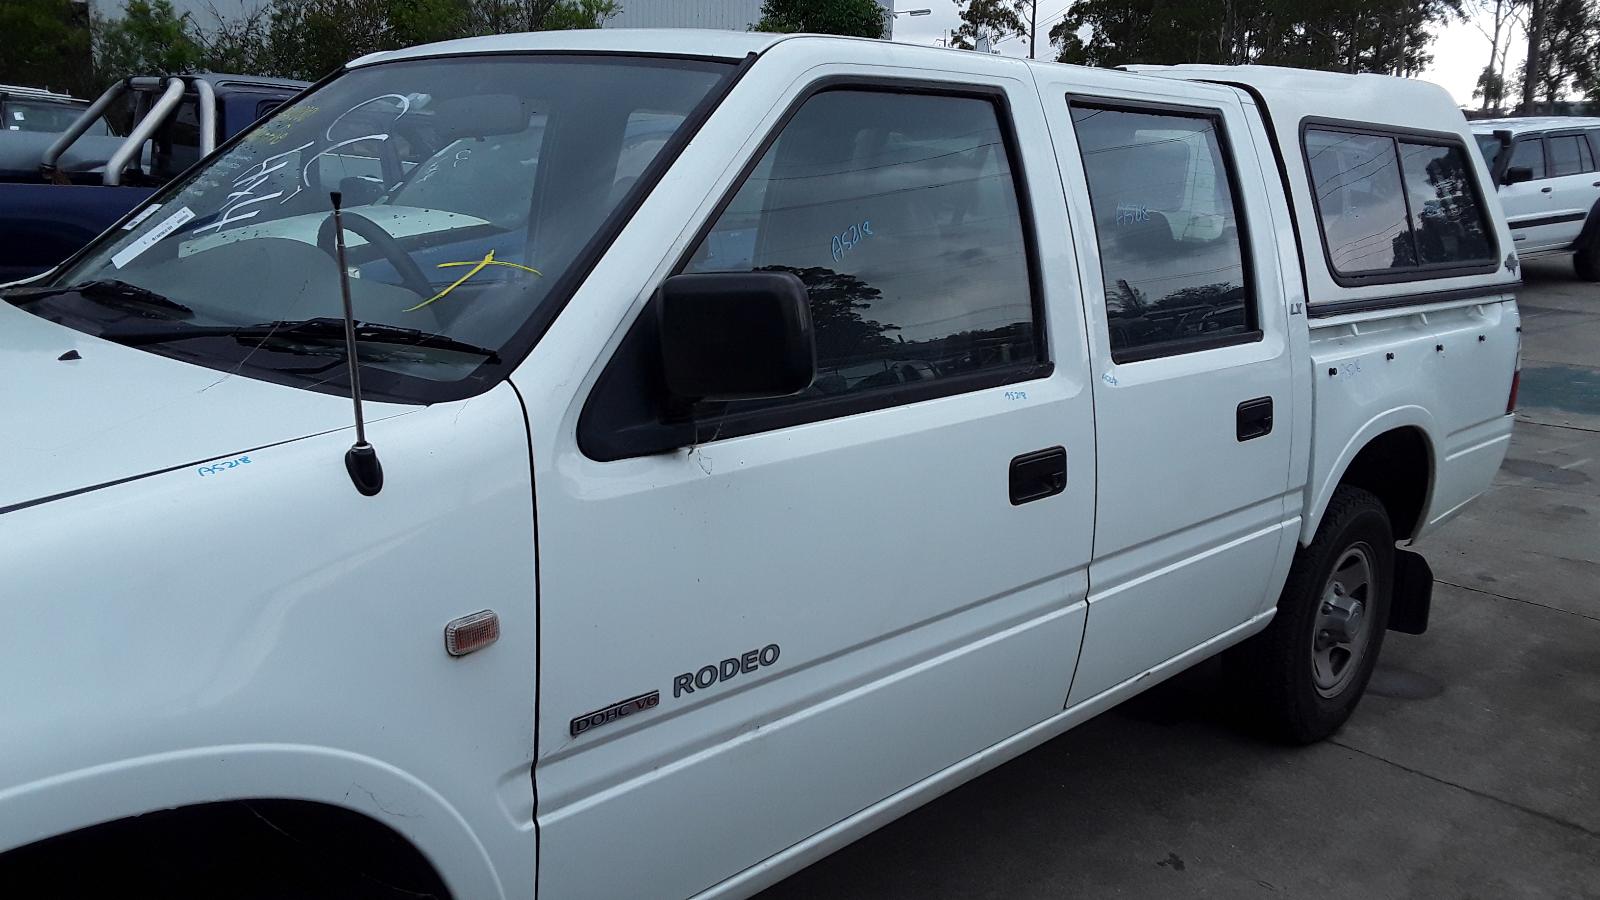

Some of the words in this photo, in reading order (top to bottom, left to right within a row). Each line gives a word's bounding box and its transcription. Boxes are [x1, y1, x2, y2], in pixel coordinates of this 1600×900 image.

[1289, 302, 1303, 315] LX
[673, 643, 781, 698] RODEO
[575, 704, 631, 733] DOHC
[635, 694, 658, 710] V6
